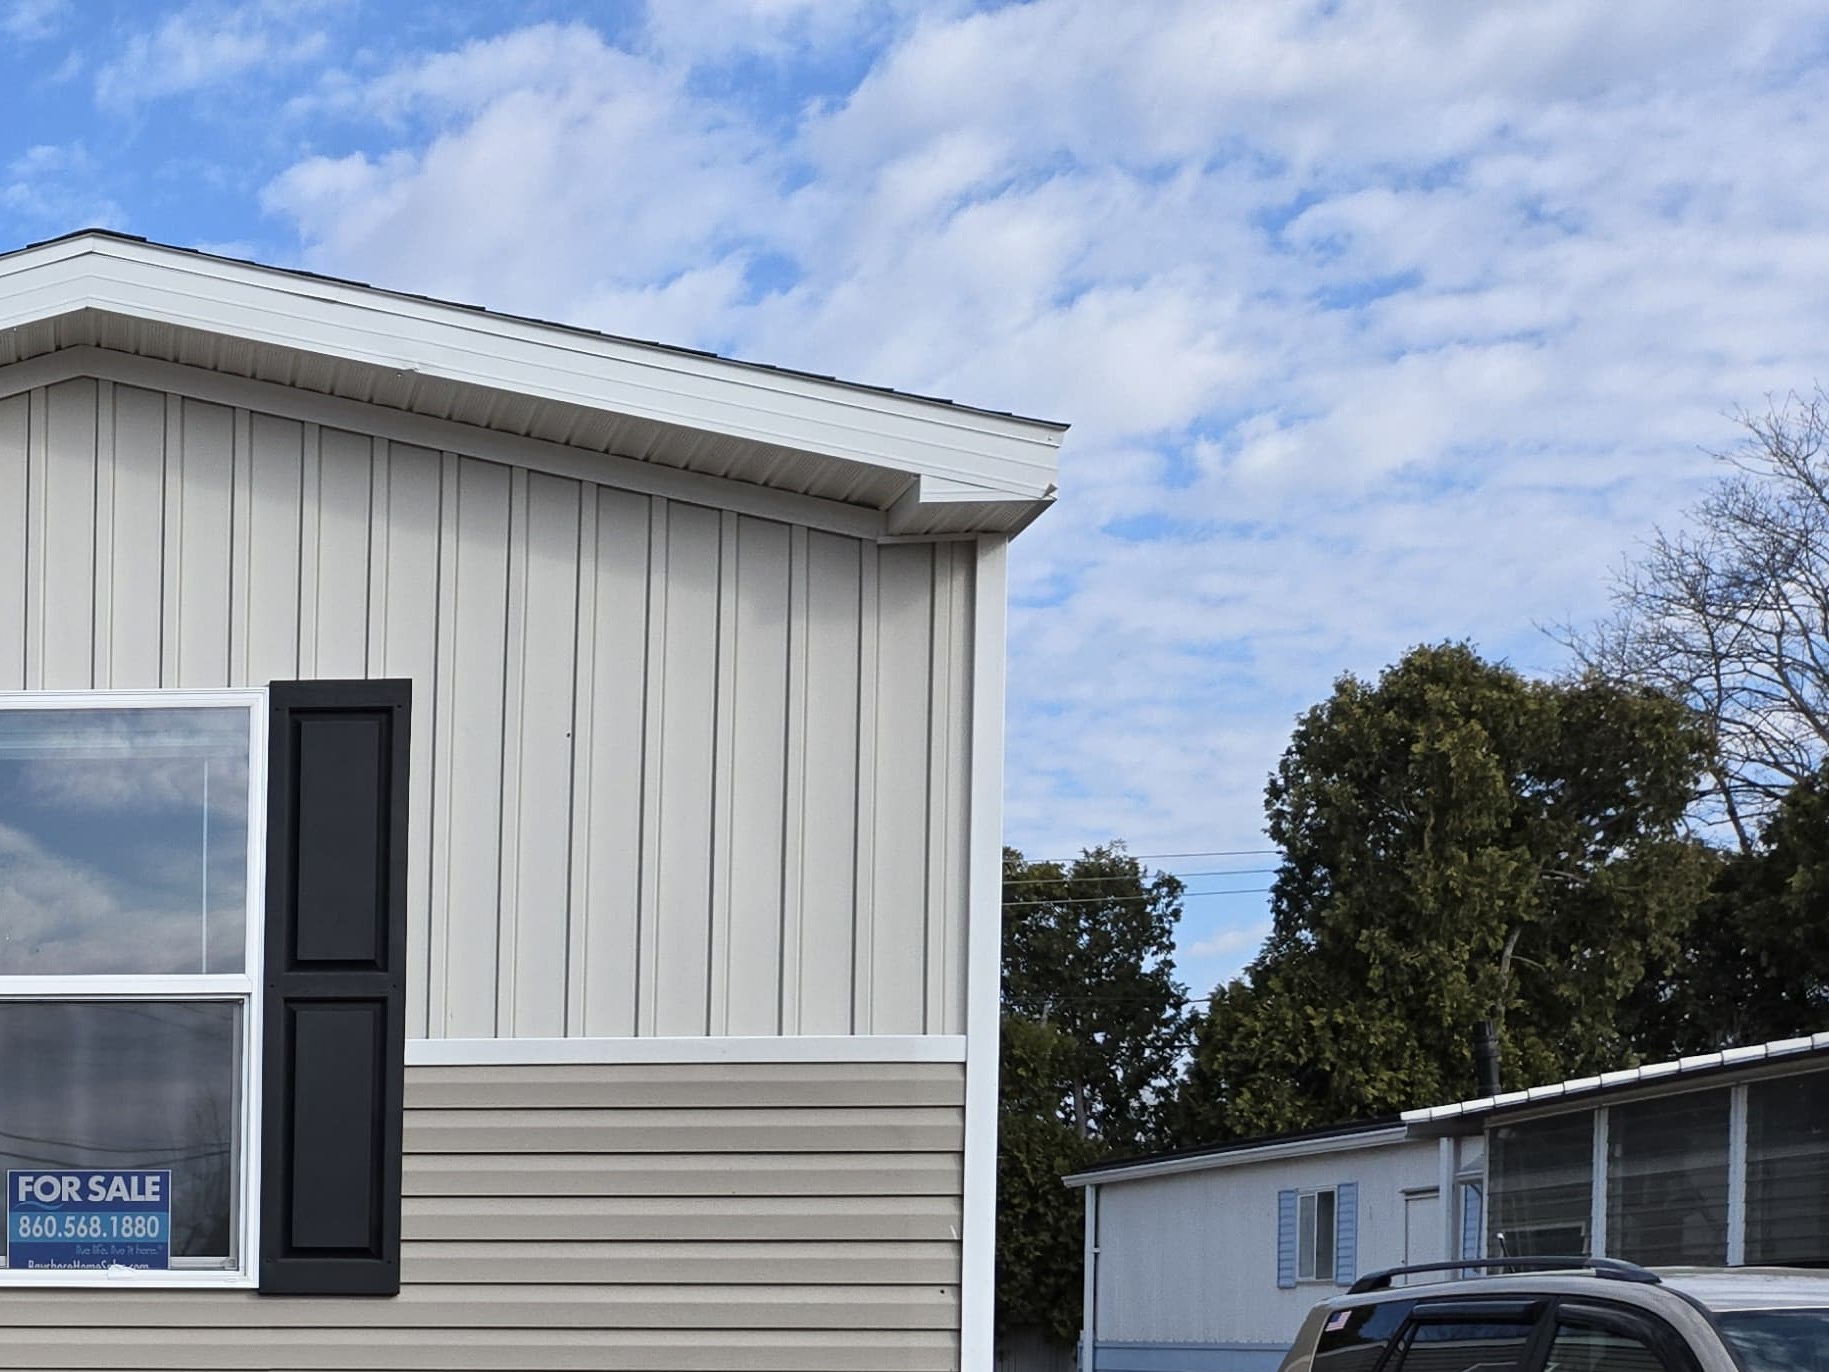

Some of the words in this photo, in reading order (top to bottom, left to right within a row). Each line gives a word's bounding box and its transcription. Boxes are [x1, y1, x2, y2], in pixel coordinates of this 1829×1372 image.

[18, 1175, 83, 1202] FOR
[88, 1175, 161, 1202] SALE
[19, 1215, 159, 1238] 860.568.1880
